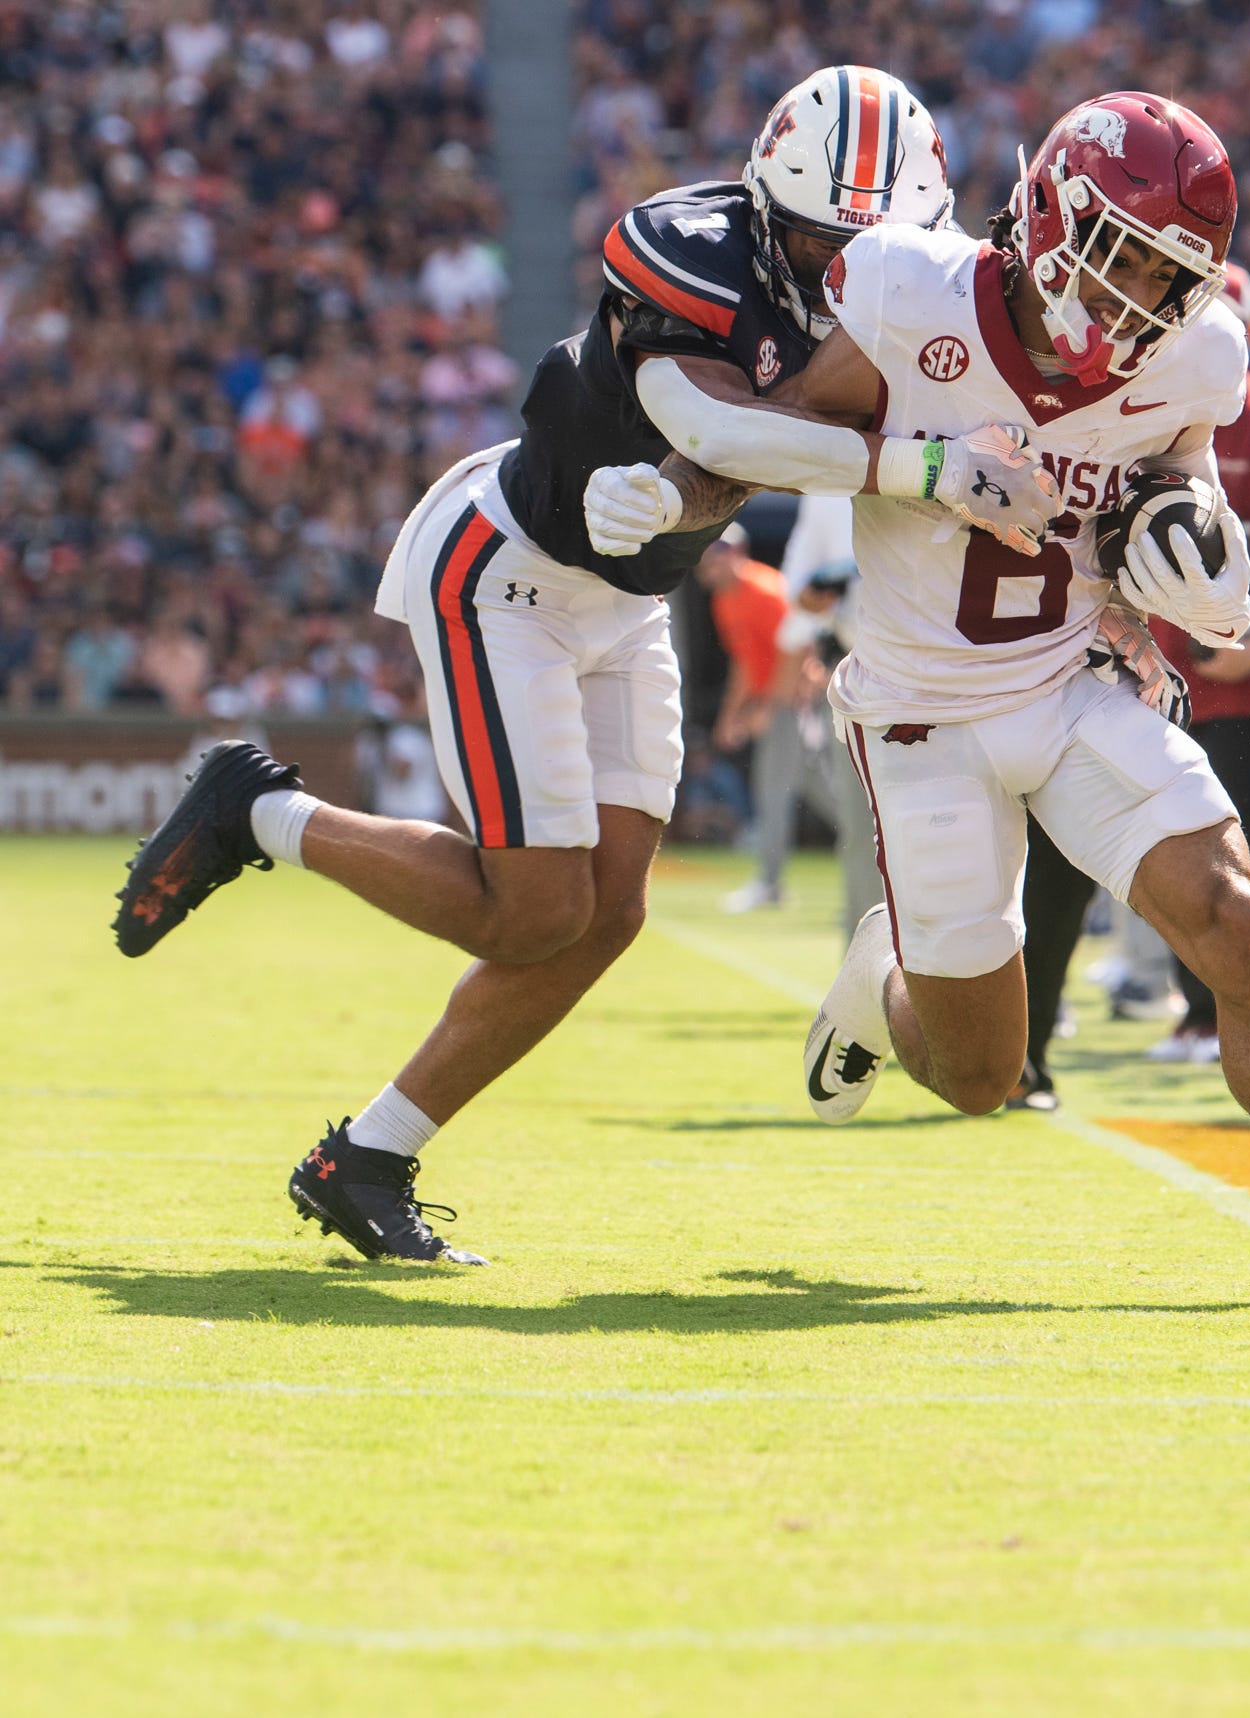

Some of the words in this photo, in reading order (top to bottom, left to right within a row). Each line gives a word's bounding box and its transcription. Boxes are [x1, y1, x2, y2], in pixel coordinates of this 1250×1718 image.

[837, 208, 883, 226] TIGERS
[1177, 232, 1206, 253] HOGS
[760, 339, 776, 374] SEC
[923, 340, 965, 379] SEC
[955, 511, 1081, 645] 6
